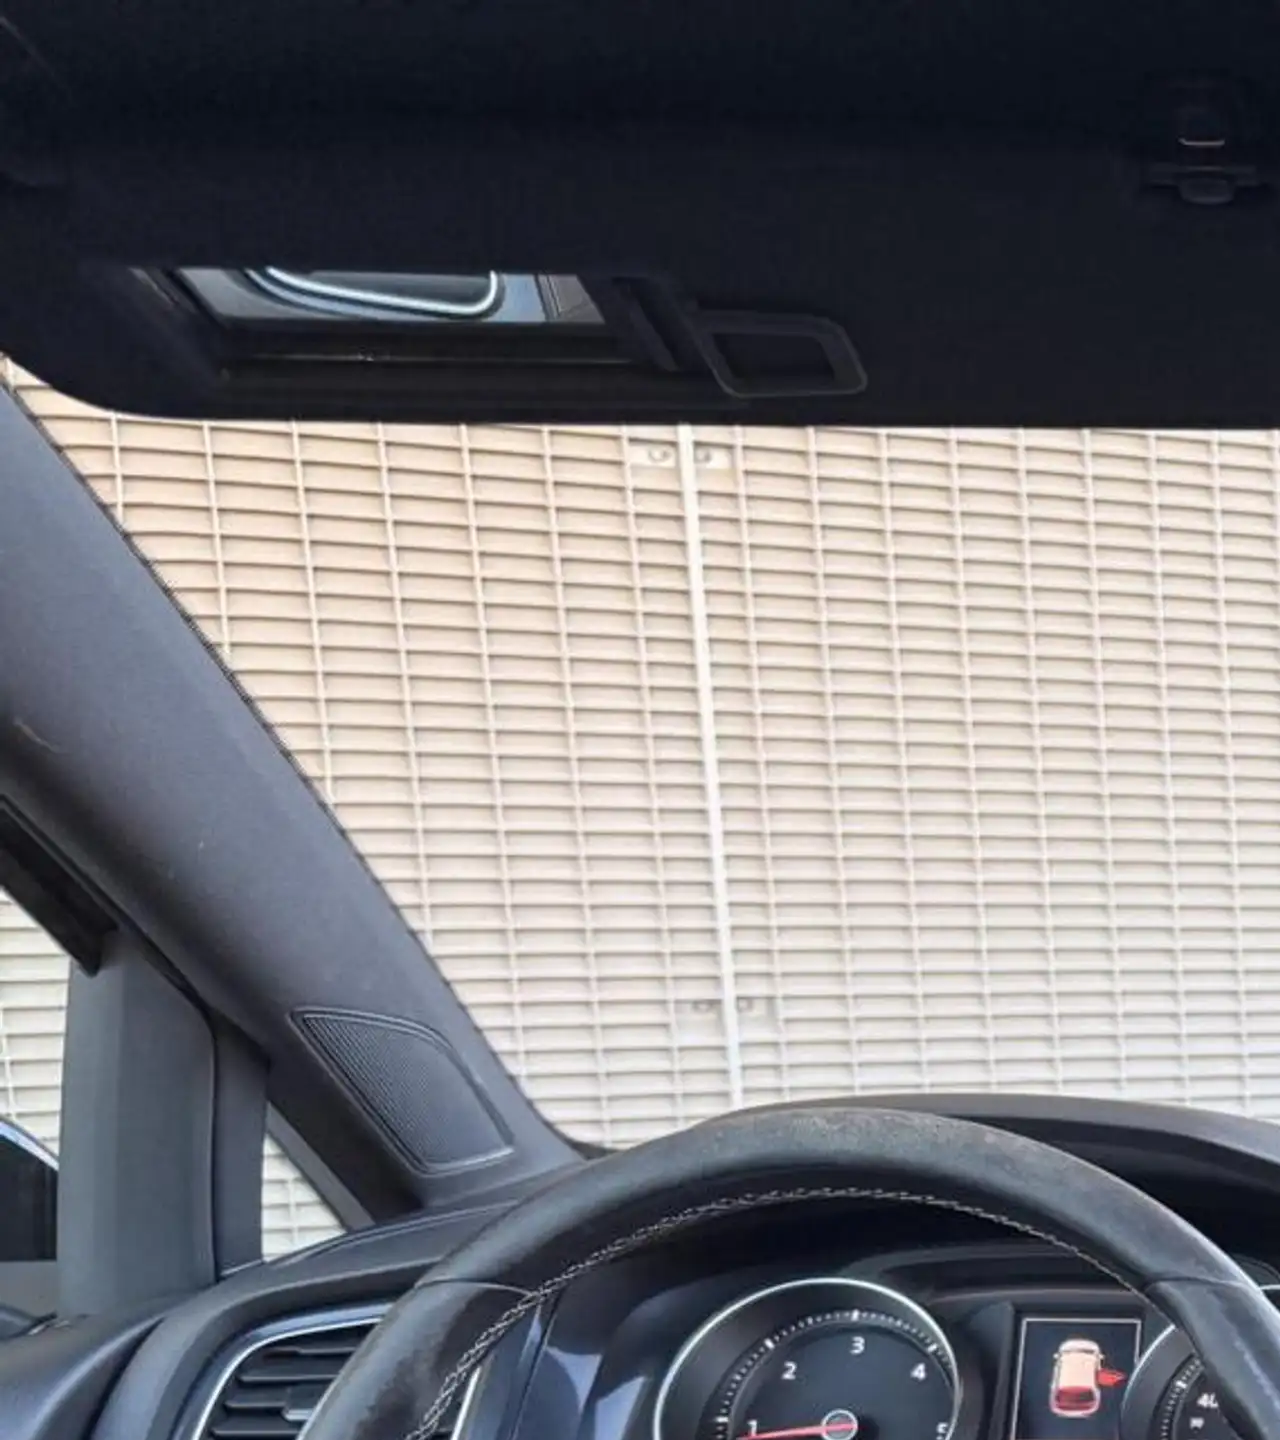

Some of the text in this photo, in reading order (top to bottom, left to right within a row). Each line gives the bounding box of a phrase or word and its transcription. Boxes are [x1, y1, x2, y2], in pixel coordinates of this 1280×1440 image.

[850, 1336, 865, 1354] 3
[781, 1361, 798, 1380] 2
[910, 1362, 927, 1381] 4
[747, 1419, 759, 1438] 1
